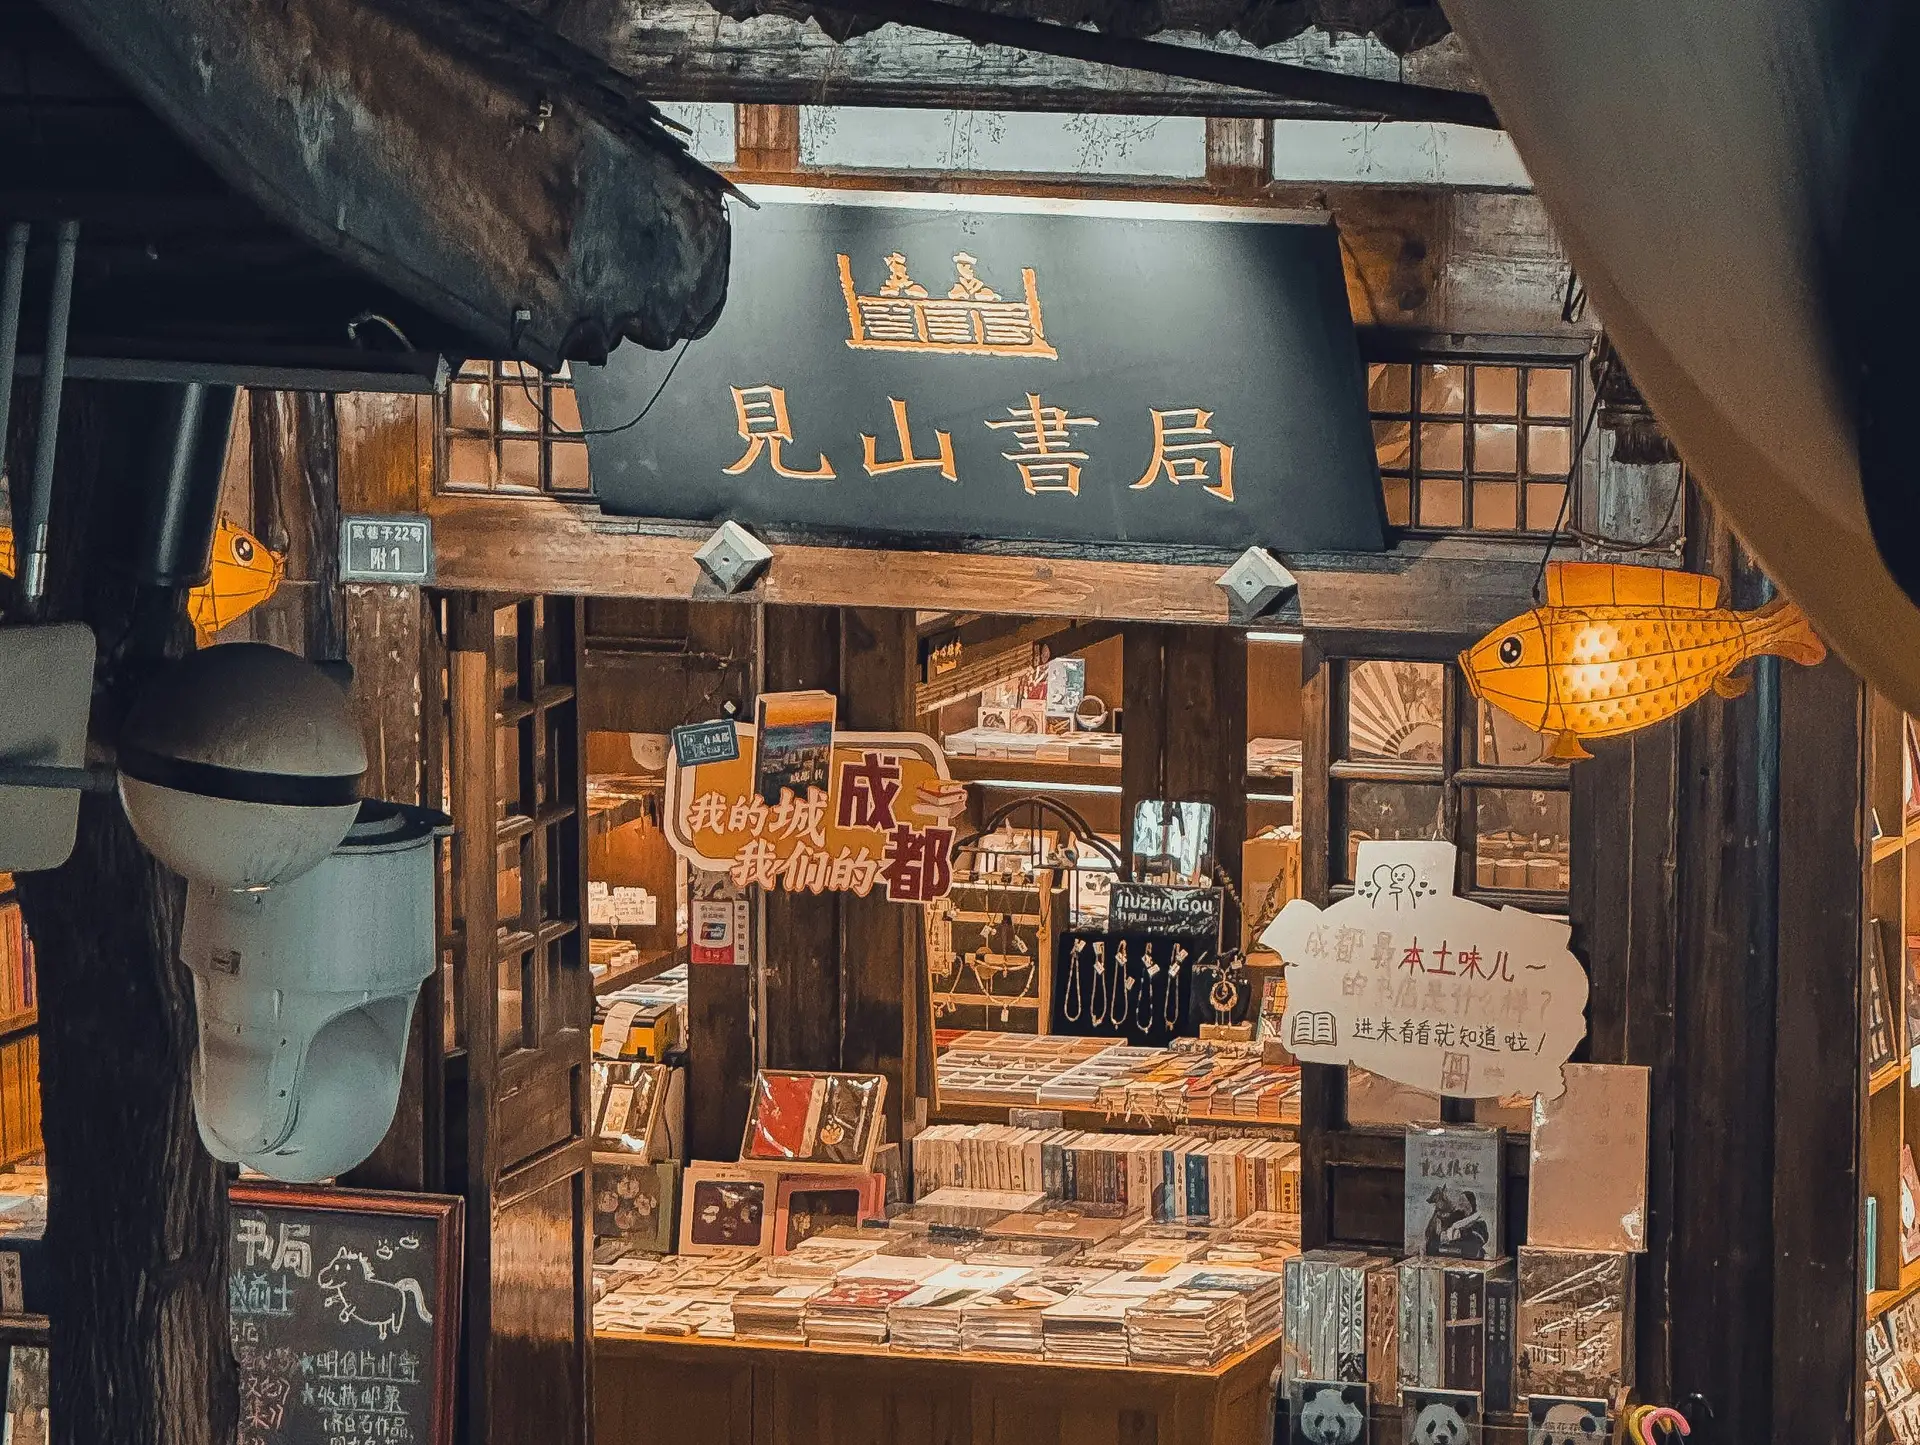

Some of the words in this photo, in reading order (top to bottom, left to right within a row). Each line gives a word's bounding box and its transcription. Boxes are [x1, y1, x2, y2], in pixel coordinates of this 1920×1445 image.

[722, 384, 1236, 502] 見山書局
[370, 547, 400, 570] 附1
[688, 785, 828, 848] 我的城
[731, 838, 878, 896] 我们的
[1352, 1017, 1547, 1056] 进来看看就知道啦!
[236, 1219, 312, 1279] 书局
